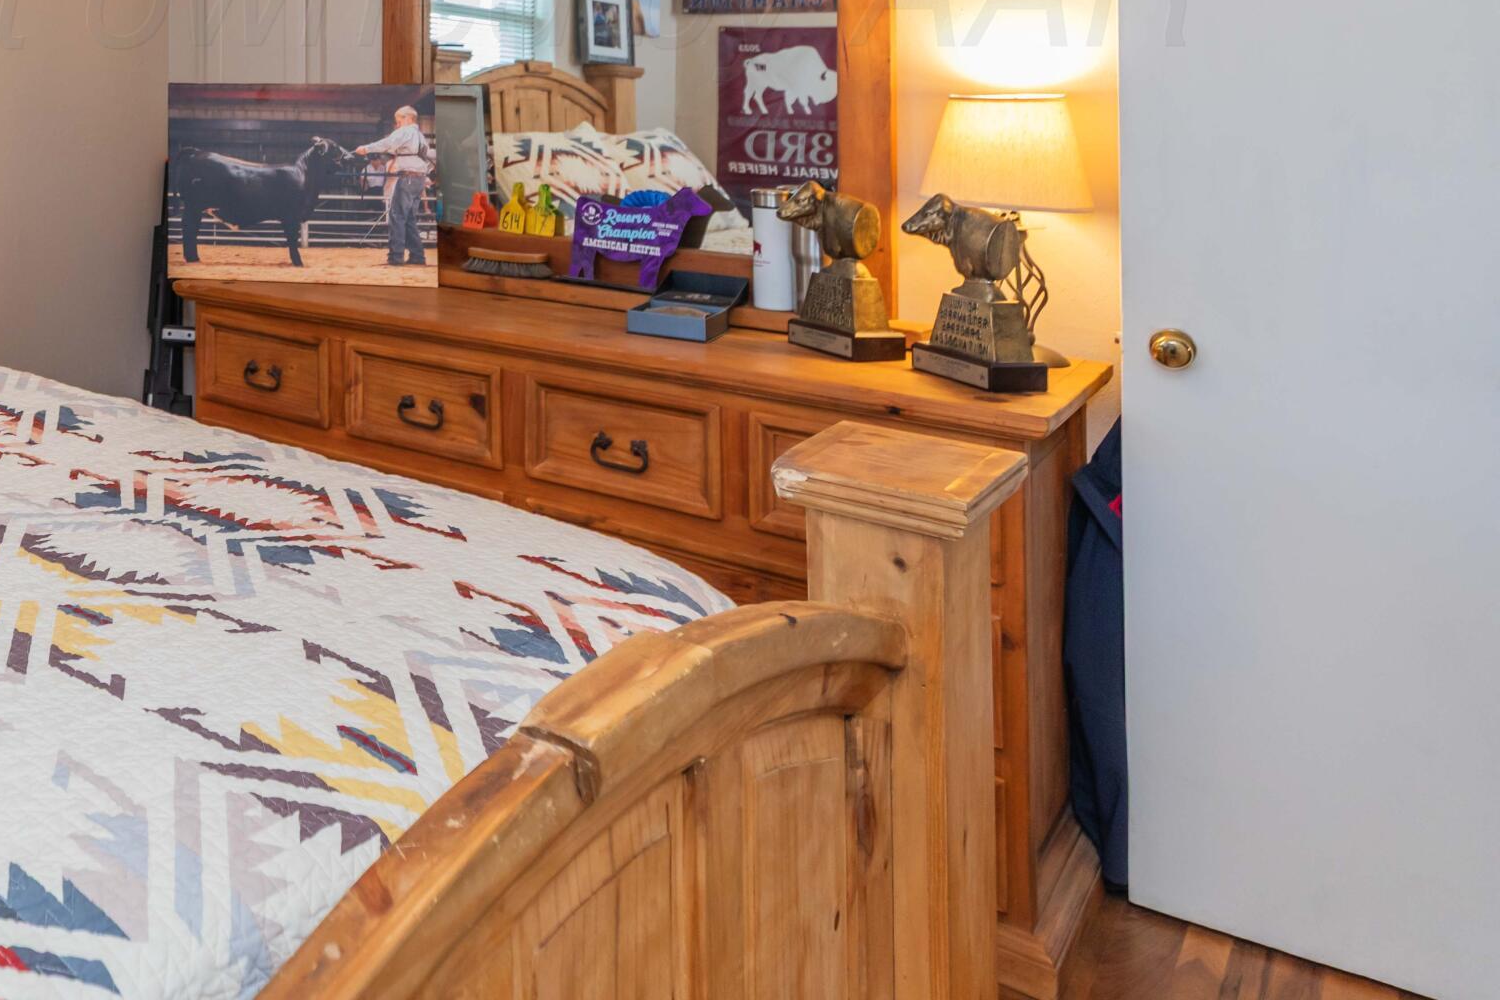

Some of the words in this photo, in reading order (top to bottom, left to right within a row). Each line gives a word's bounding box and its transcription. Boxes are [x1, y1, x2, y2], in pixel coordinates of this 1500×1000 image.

[501, 211, 521, 230] 614
[603, 208, 651, 226] Reserve
[598, 224, 658, 242] Champion
[582, 237, 628, 251] AMERICAN
[629, 244, 661, 256] HEIFER
